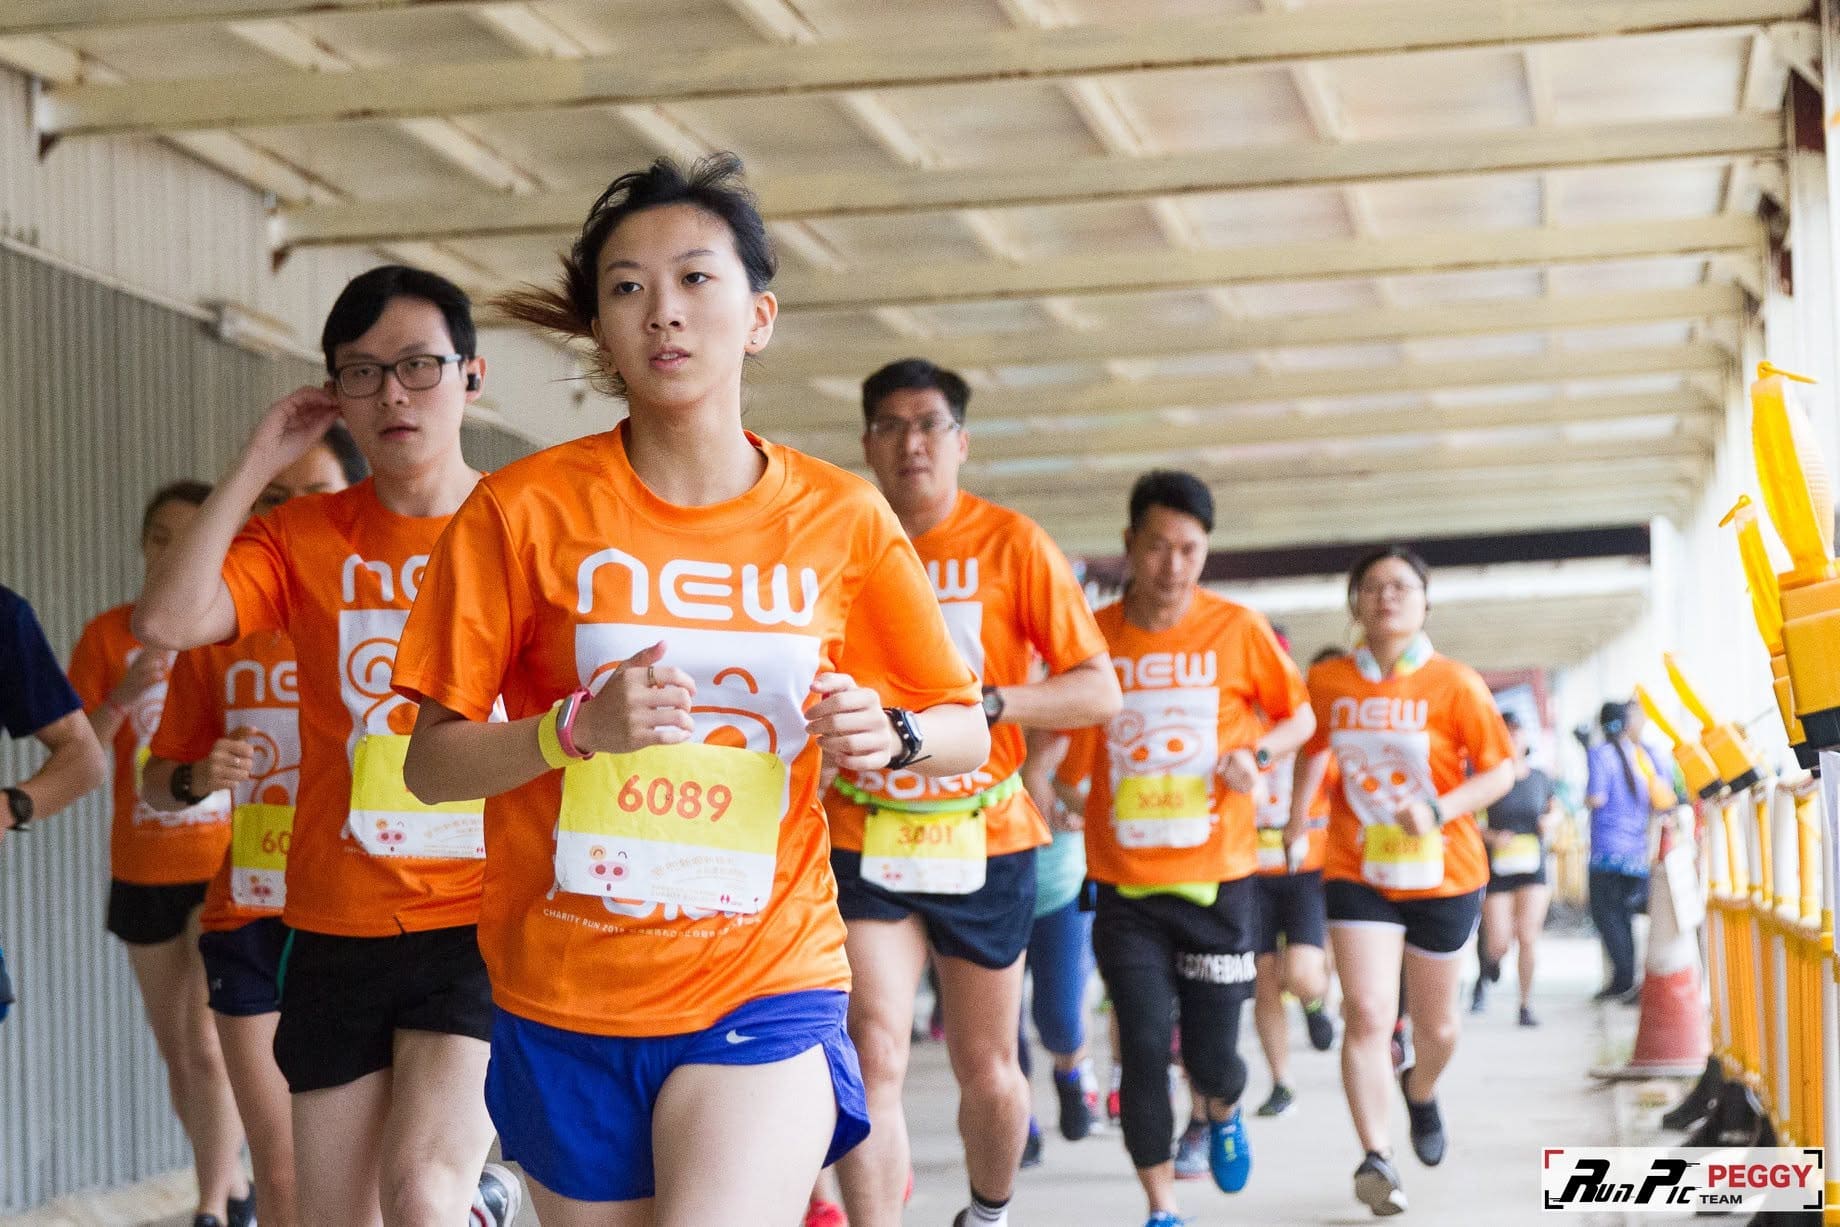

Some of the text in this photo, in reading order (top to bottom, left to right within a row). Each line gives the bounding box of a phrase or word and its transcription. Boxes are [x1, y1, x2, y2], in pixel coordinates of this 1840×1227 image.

[617, 774, 733, 822] 6089
[543, 907, 581, 924] CHARITY
[582, 917, 601, 931] RUN
